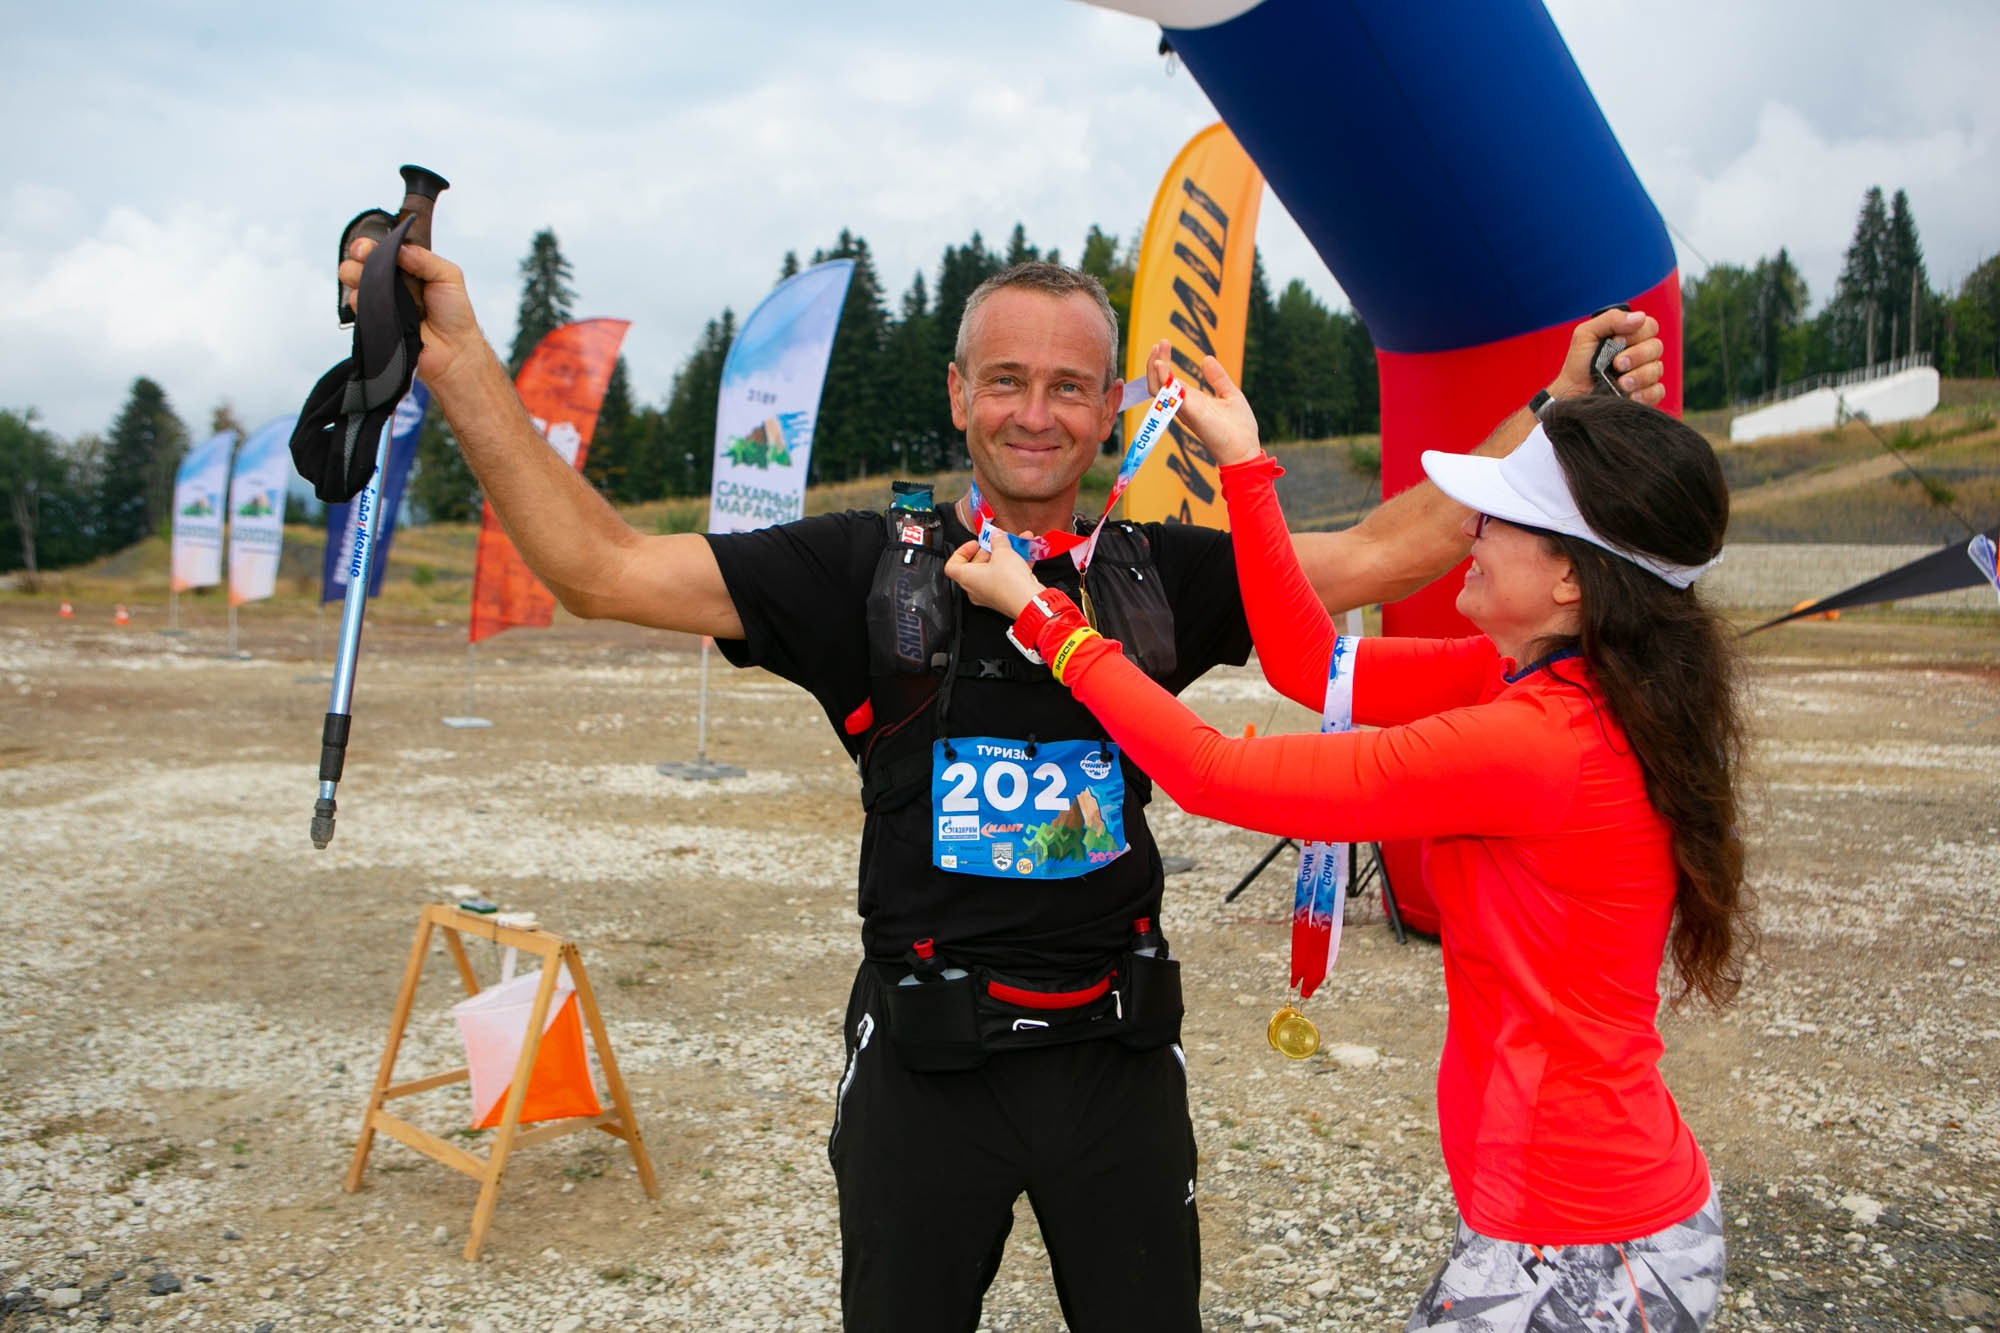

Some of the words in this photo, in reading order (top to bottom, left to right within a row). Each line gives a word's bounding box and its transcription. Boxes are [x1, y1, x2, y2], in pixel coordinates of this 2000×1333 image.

[1136, 417, 1160, 450] СОЧИ
[717, 481, 799, 509] САХАРНЫЙ
[941, 761, 1071, 812] 202
[1302, 853, 1314, 882] СОЧИ
[1322, 854, 1334, 886] СОЧИ
